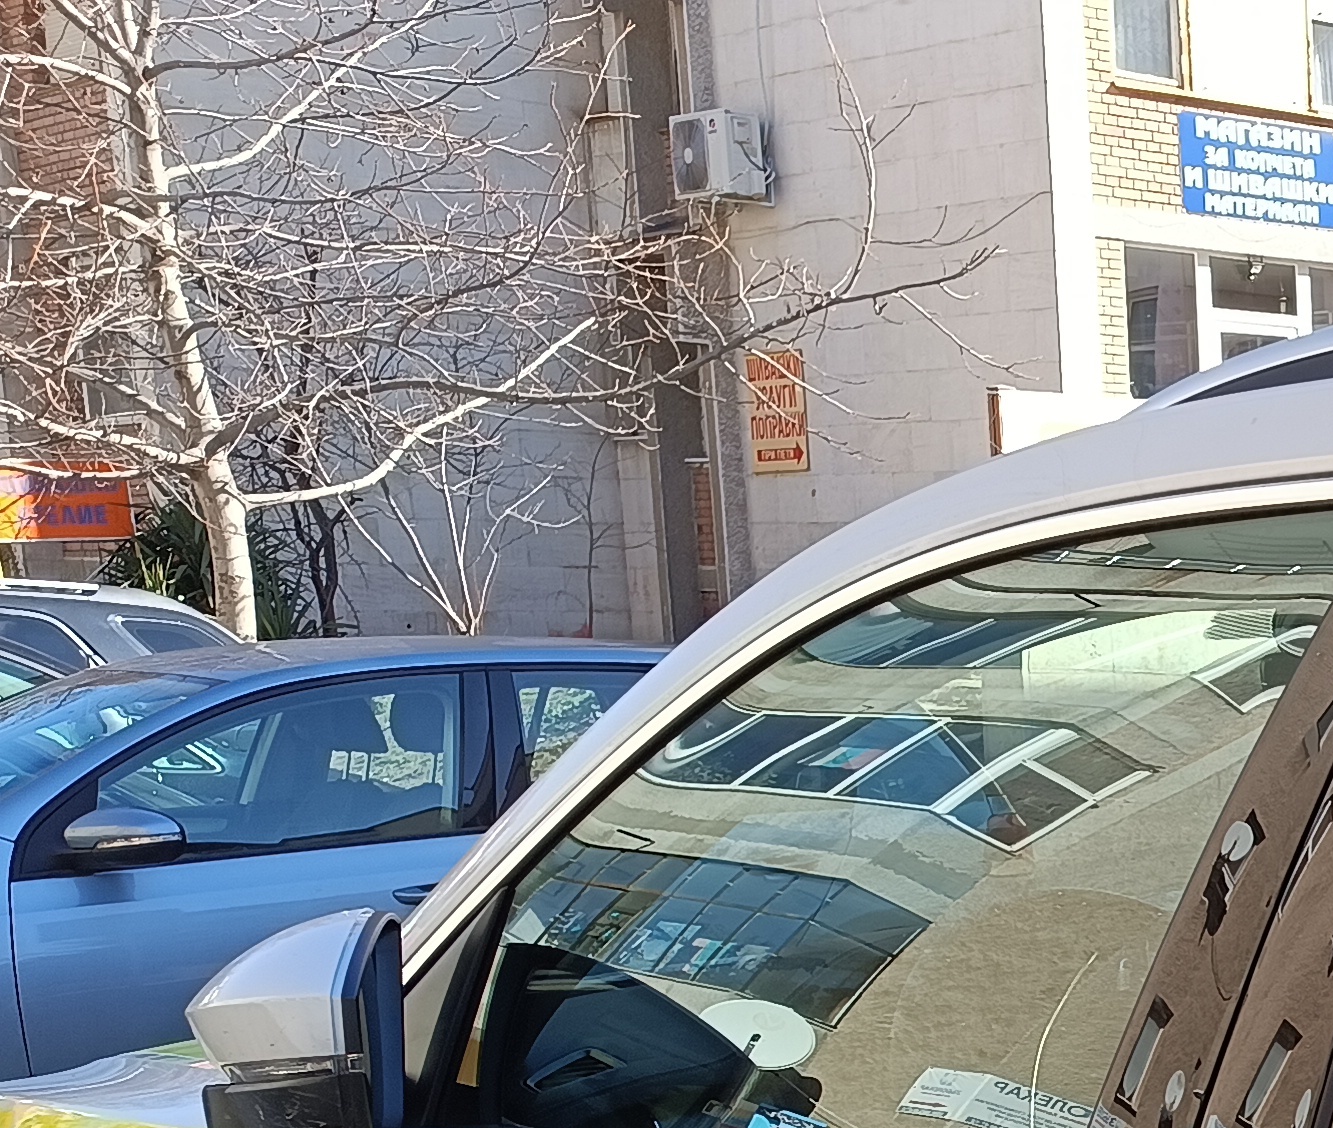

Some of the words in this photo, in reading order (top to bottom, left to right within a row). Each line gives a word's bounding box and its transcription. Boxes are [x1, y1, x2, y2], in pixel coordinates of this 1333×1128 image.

[1194, 115, 1321, 154] МАГАЗИН
[1203, 145, 1230, 168] ЗА
[1183, 165, 1204, 189] И
[1204, 192, 1321, 225] МАТЕРИАЛИ
